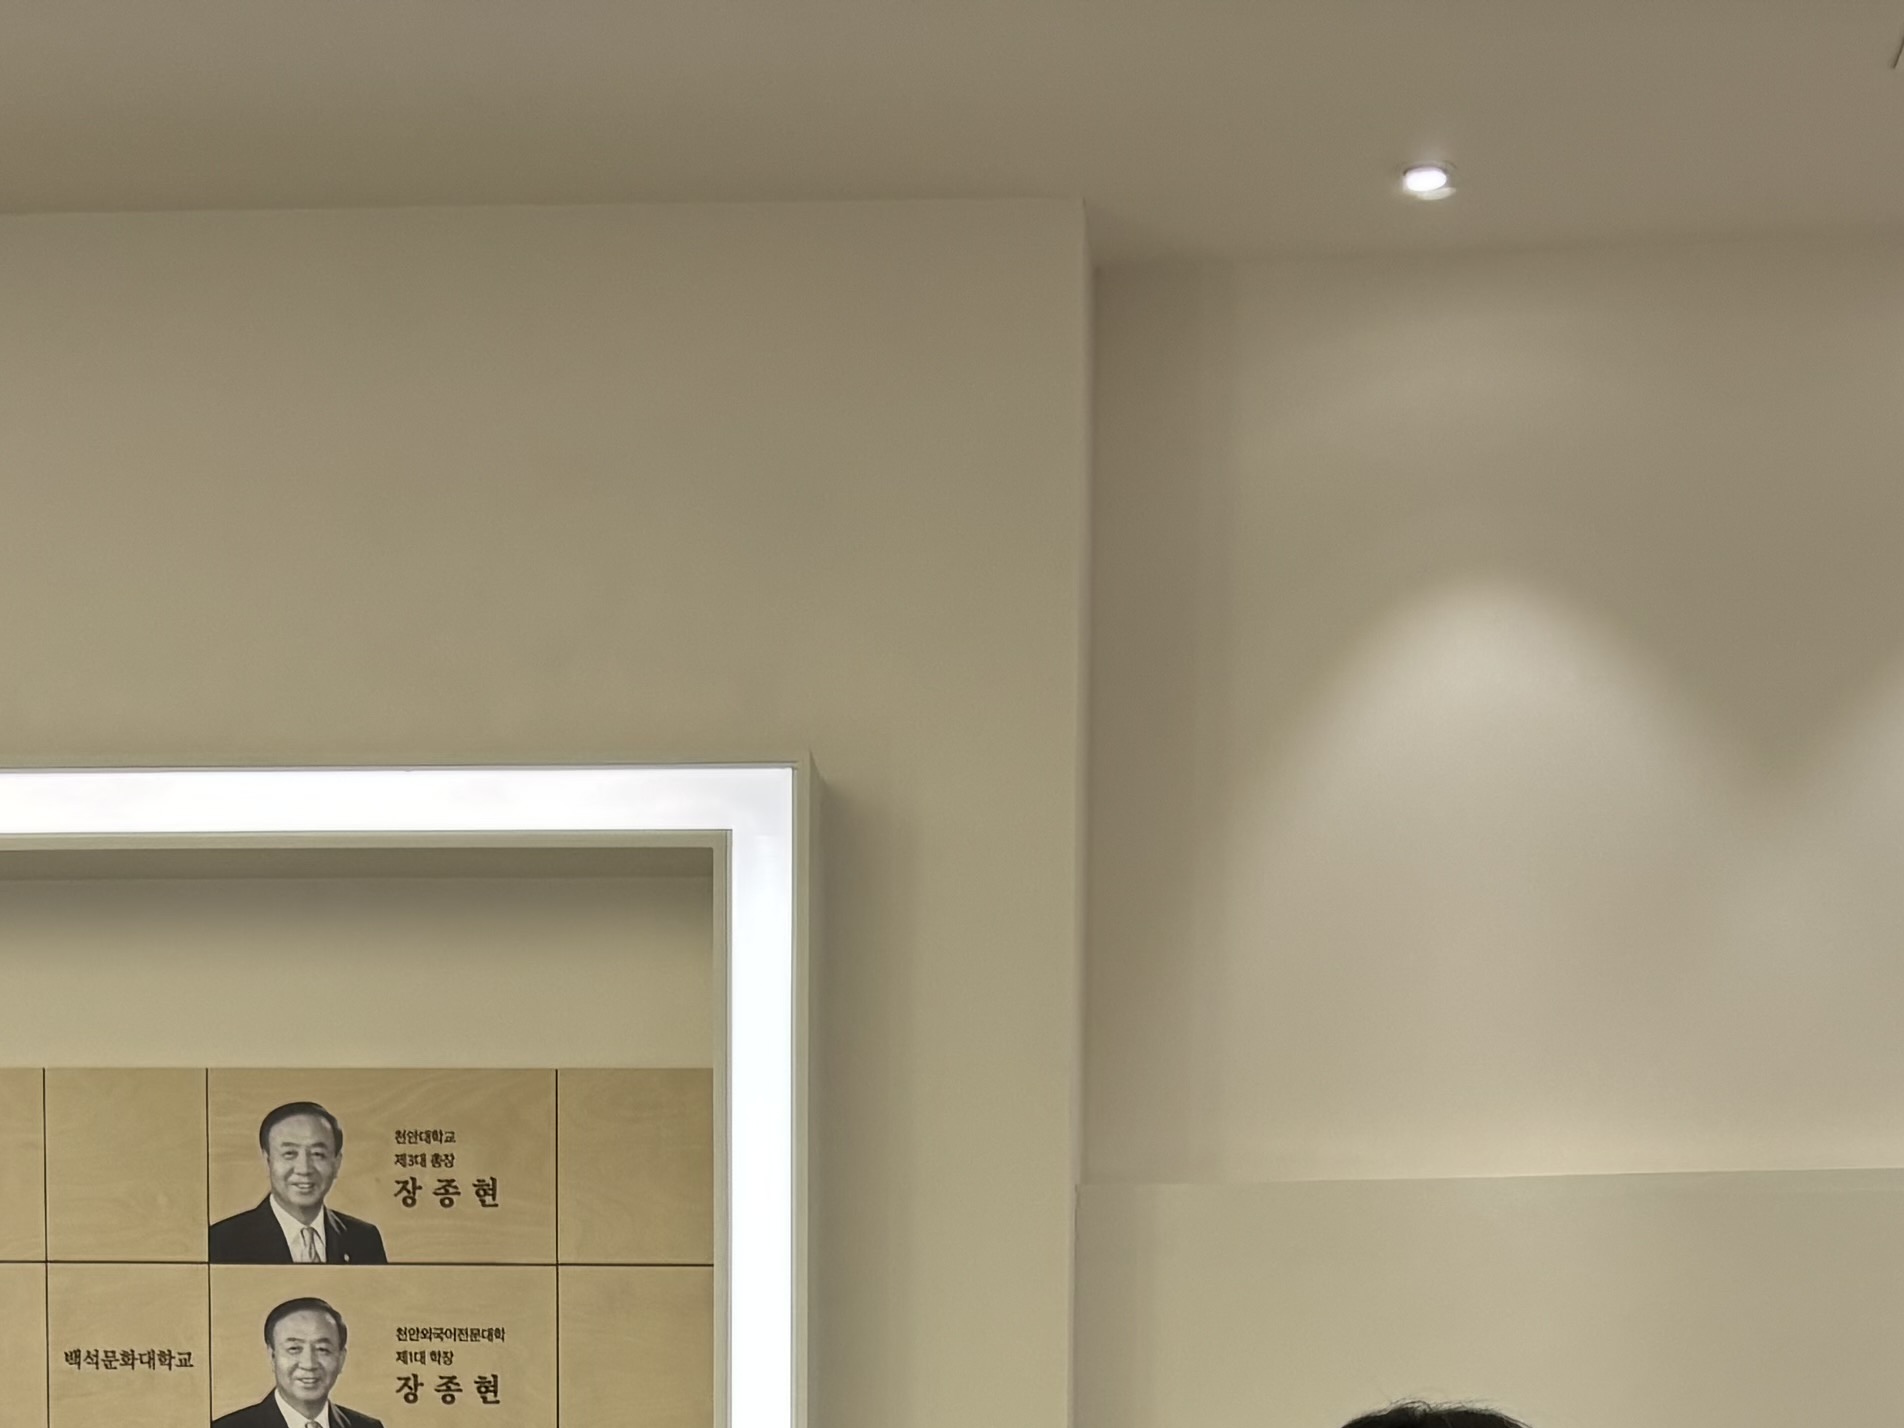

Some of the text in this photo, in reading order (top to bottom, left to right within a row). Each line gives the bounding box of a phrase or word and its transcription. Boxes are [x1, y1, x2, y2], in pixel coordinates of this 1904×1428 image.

[394, 1128, 457, 1145] 천안대학교
[394, 1152, 456, 1169] 제3대 총장
[393, 1175, 499, 1209] 장종현
[395, 1326, 506, 1343] 천안외국어전문대학
[63, 1348, 195, 1371] 백석문화대학교
[395, 1349, 455, 1366] 제1대 학장
[395, 1372, 501, 1406] 장종현
